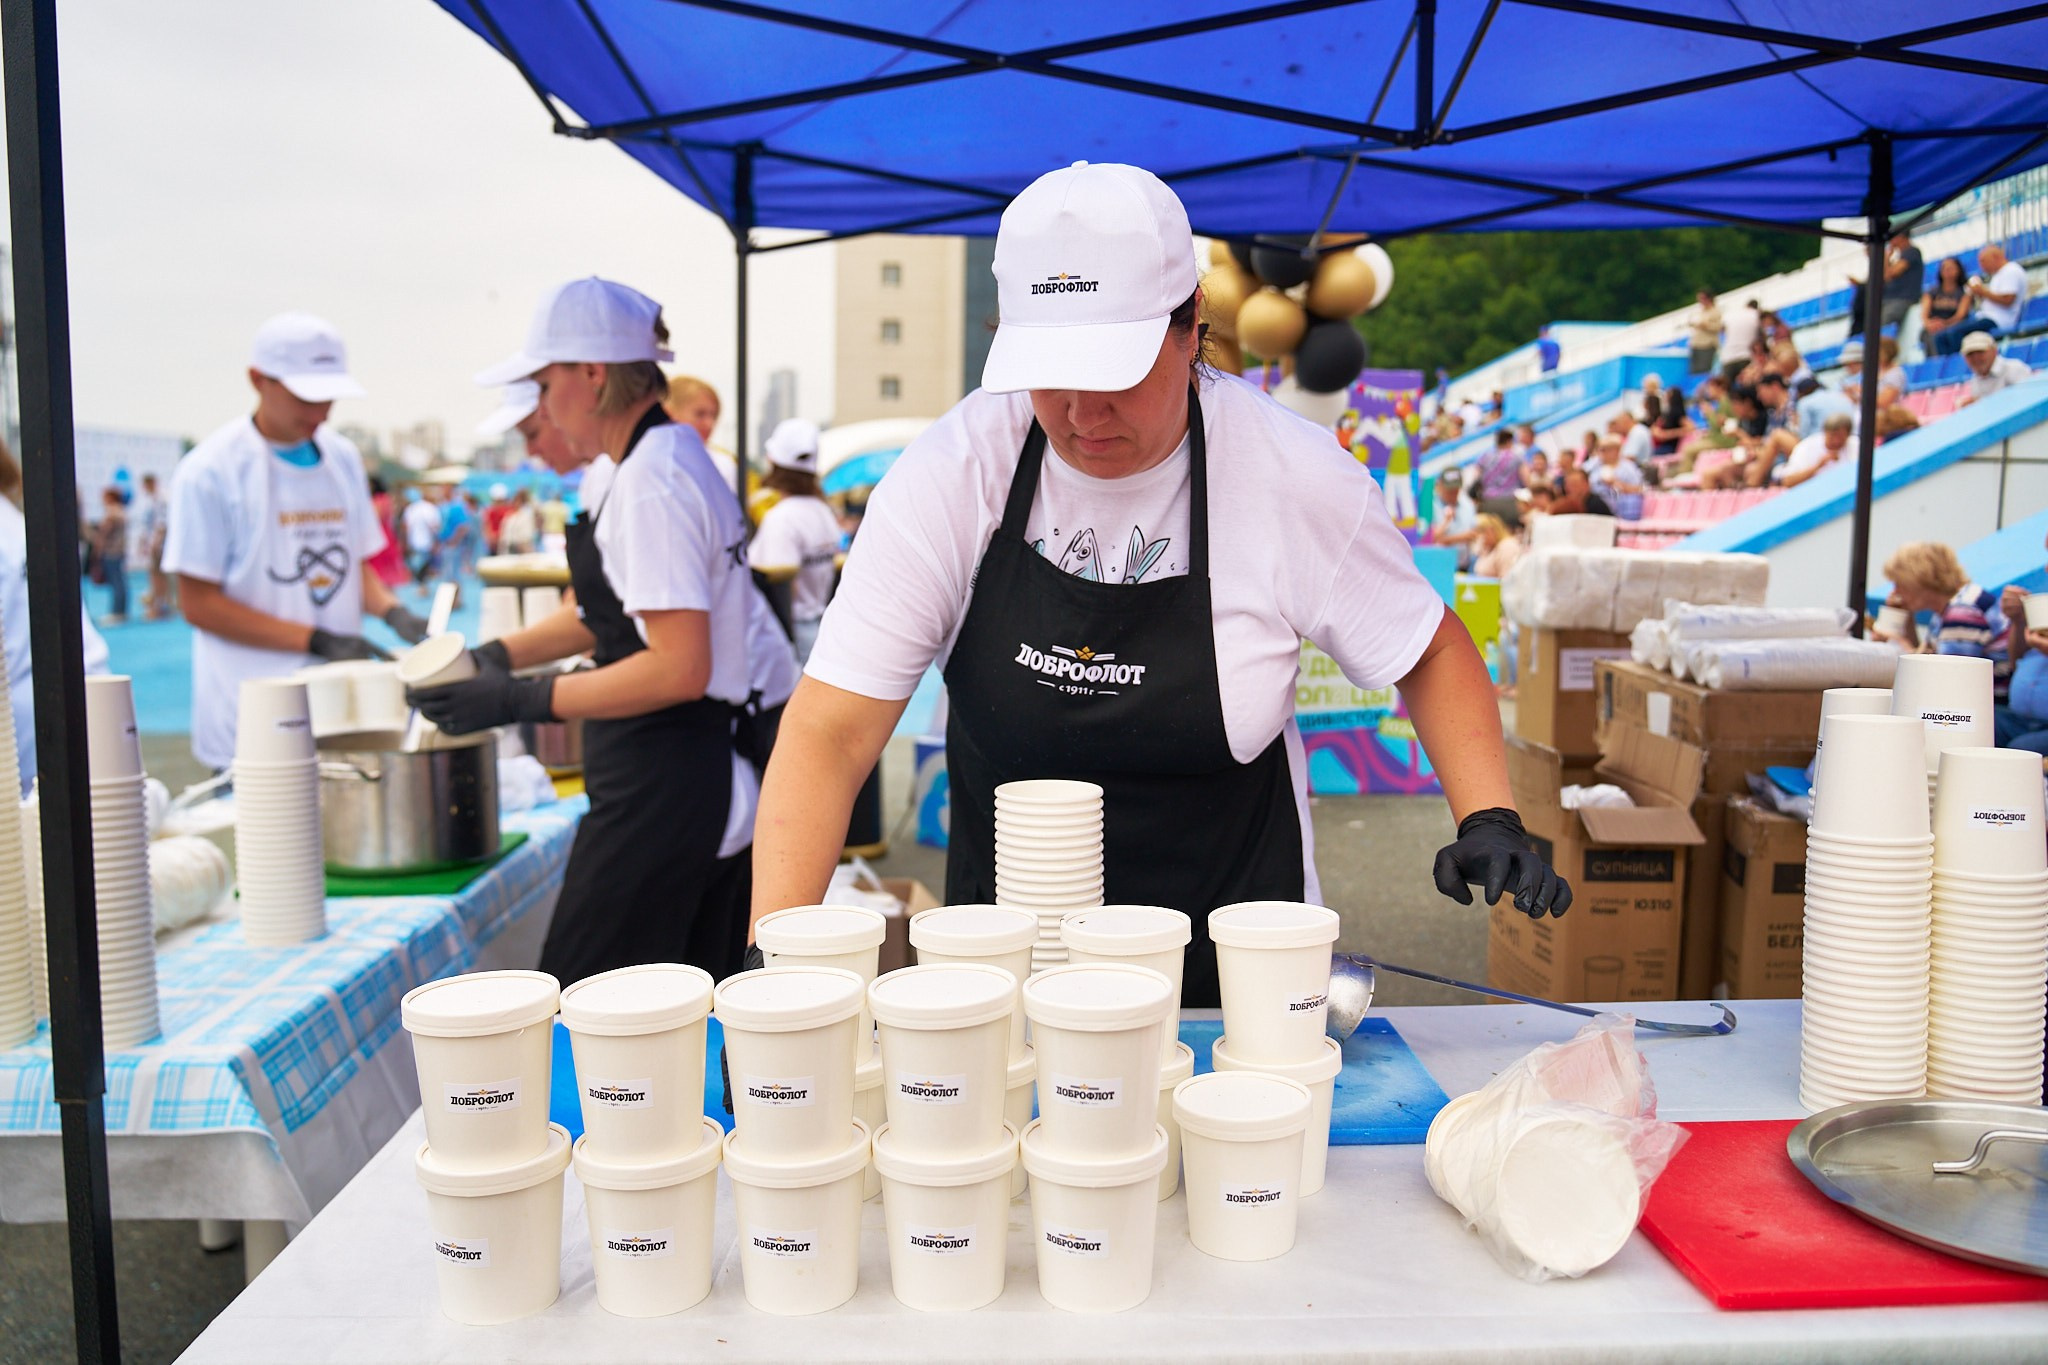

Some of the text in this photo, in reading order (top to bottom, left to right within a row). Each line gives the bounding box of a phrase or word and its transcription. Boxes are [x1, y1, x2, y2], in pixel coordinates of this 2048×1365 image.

[1031, 280, 1099, 295] ДОБРОФЛОТ
[1014, 642, 1146, 686] ДОБРОФЛОТ
[1921, 712, 1972, 723] ДОБРОФЛОТ
[1973, 812, 2026, 821] ДОБРОФЛОТ
[1592, 860, 1666, 876] СУПНИЦА
[588, 1088, 646, 1102] ДОБРОФЛОТ
[748, 1087, 808, 1100] ДОБРОФЛОТ
[901, 1084, 959, 1097] ДОБРОФЛОТ
[1056, 1086, 1116, 1101] ДОБРОФЛОТ
[450, 1091, 515, 1106] ДОБРОФЛОТ
[1226, 1191, 1281, 1203] ДОБРОФЛОТ
[607, 1240, 667, 1253] ДОБРОФЛОТ
[753, 1237, 811, 1252] ДОБРОФЛОТ
[910, 1237, 970, 1249] ДОБРОФЛОТ
[1046, 1232, 1102, 1251] ДОБРОФЛОТ
